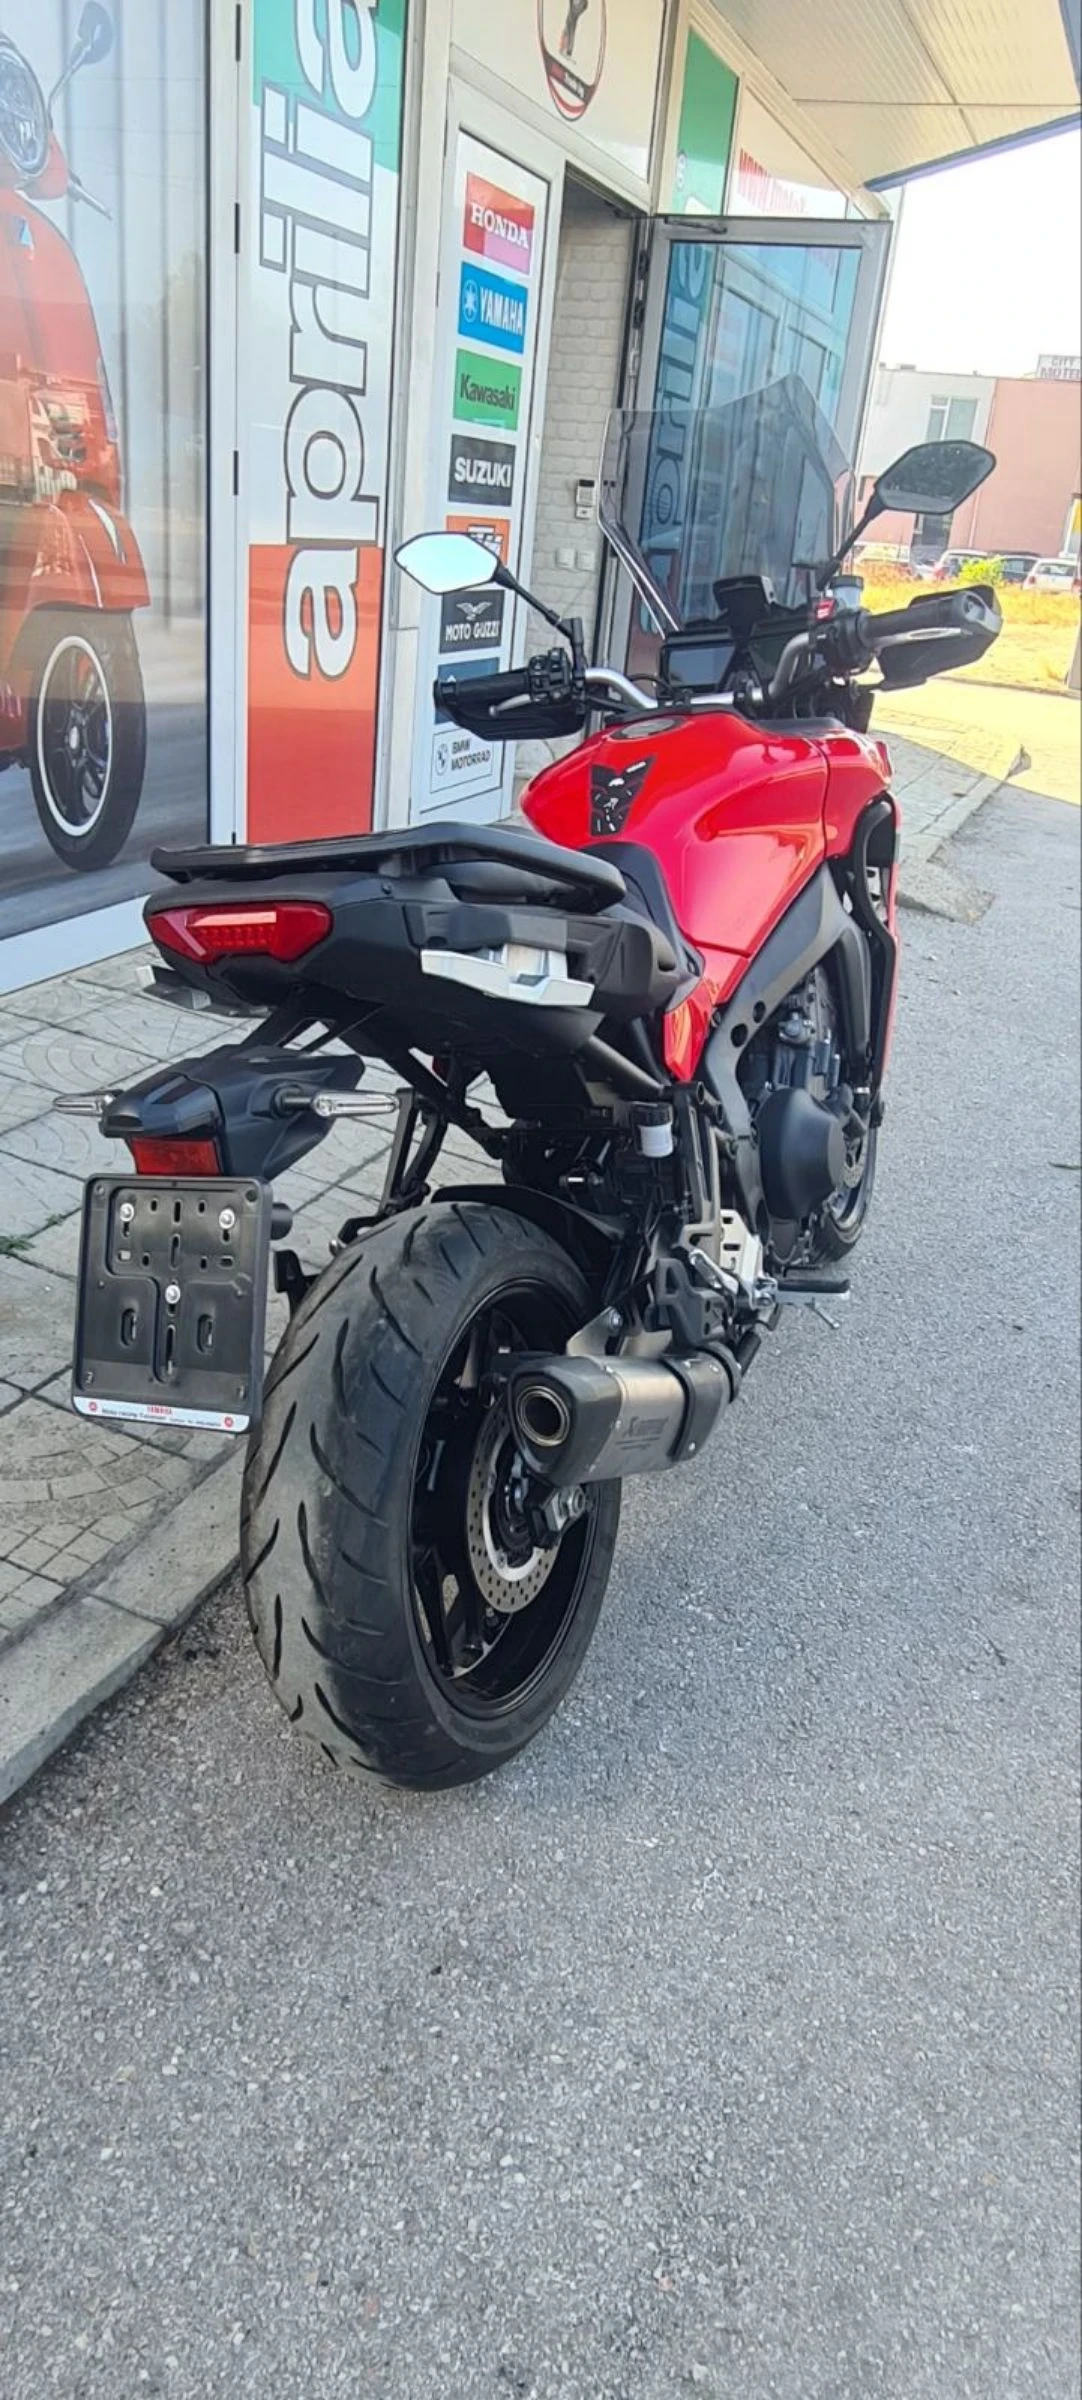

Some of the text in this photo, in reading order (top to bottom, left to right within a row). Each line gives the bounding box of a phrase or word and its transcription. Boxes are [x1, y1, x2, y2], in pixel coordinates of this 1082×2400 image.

[470, 202, 529, 248] HONDA
[479, 286, 524, 335] YAMAHA
[259, 0, 381, 682] aprilia
[460, 373, 516, 411] Kawasaki
[454, 456, 512, 488] SUZUKI
[445, 620, 500, 642] MOTO GUZZI
[450, 749, 491, 771] MOTORRAD
[451, 738, 471, 754] BMW
